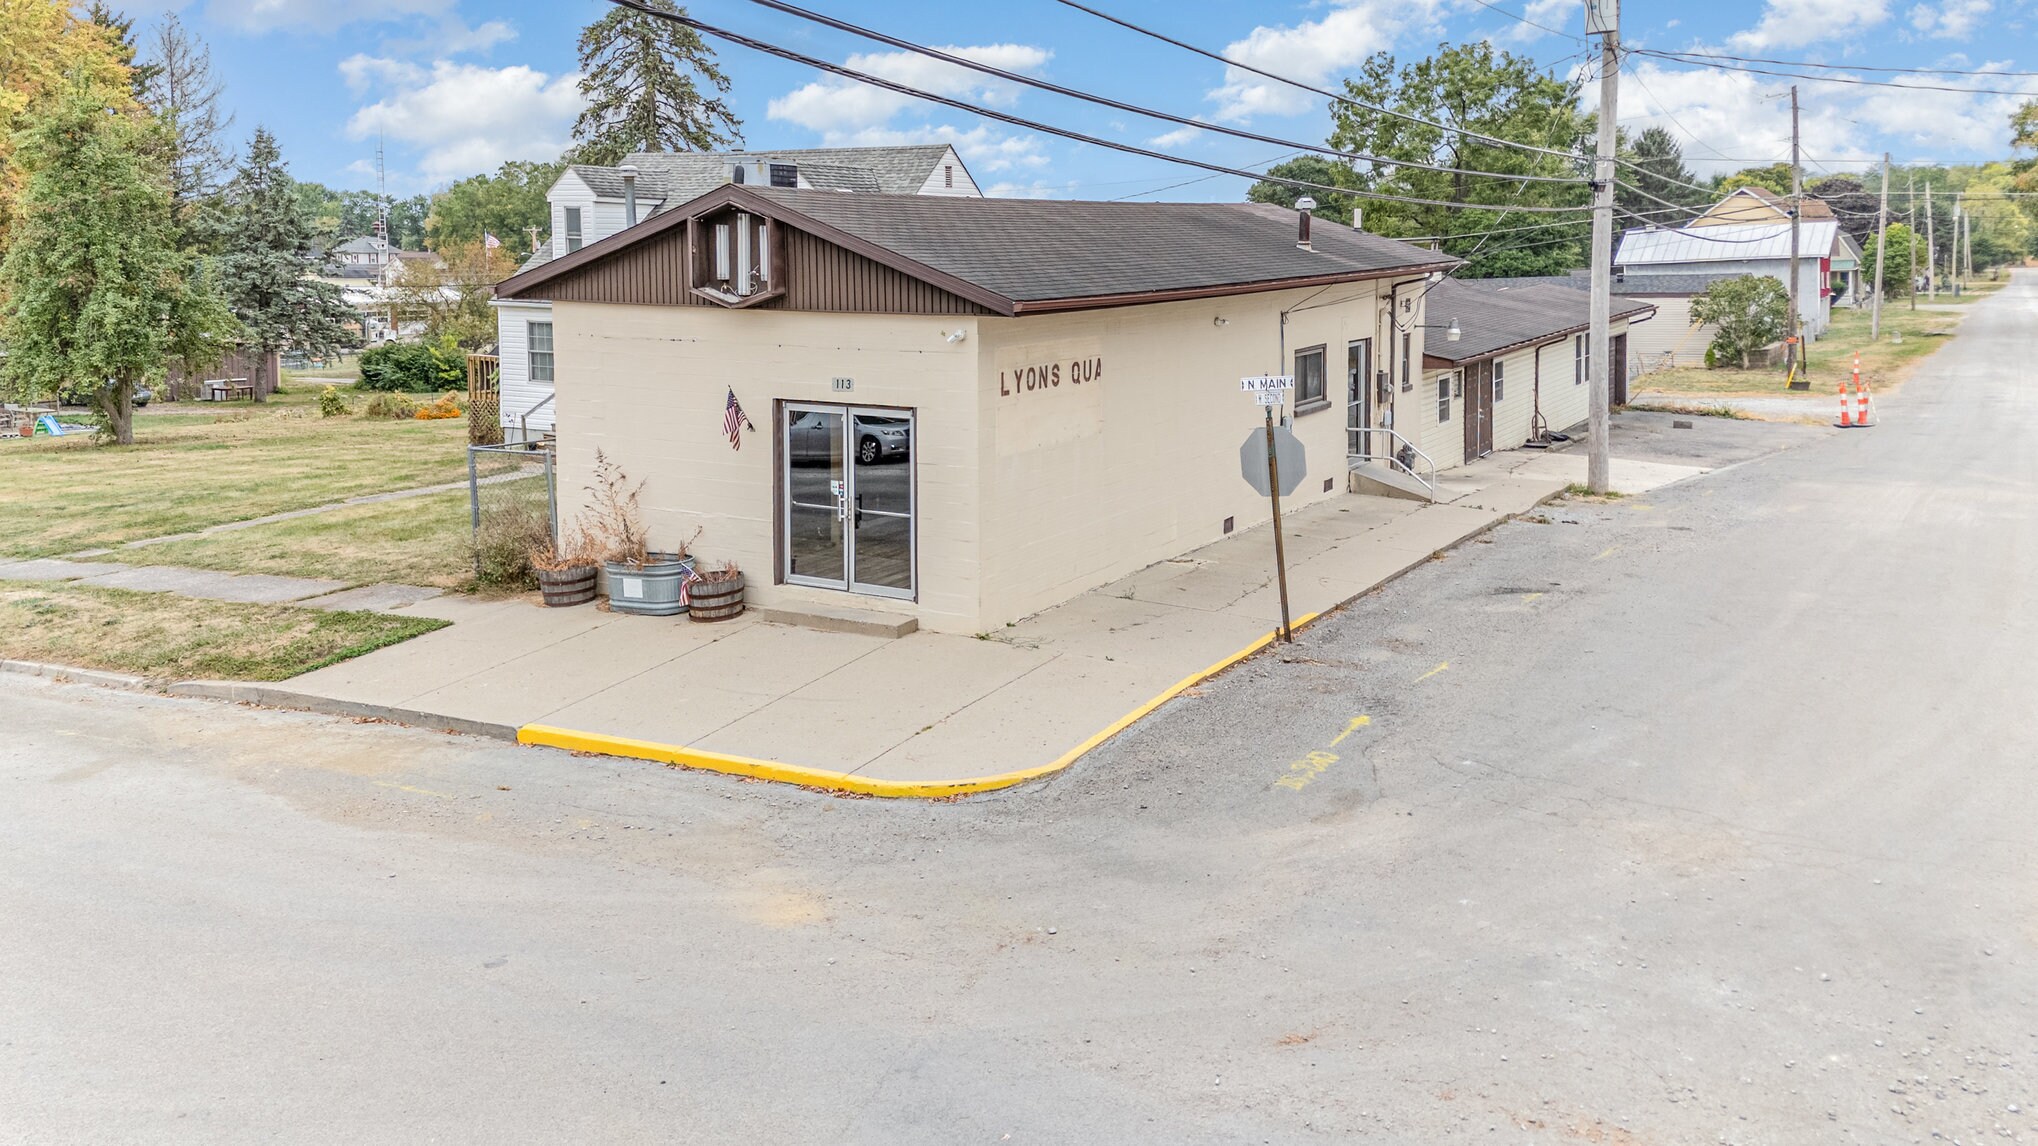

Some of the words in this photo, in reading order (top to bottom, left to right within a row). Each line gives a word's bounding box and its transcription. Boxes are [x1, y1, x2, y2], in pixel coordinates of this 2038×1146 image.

[1000, 363, 1060, 397] LYONS
[1071, 357, 1102, 385] QUA
[836, 379, 851, 390] 113
[1247, 380, 1255, 389] N
[1260, 378, 1286, 389] MAIN
